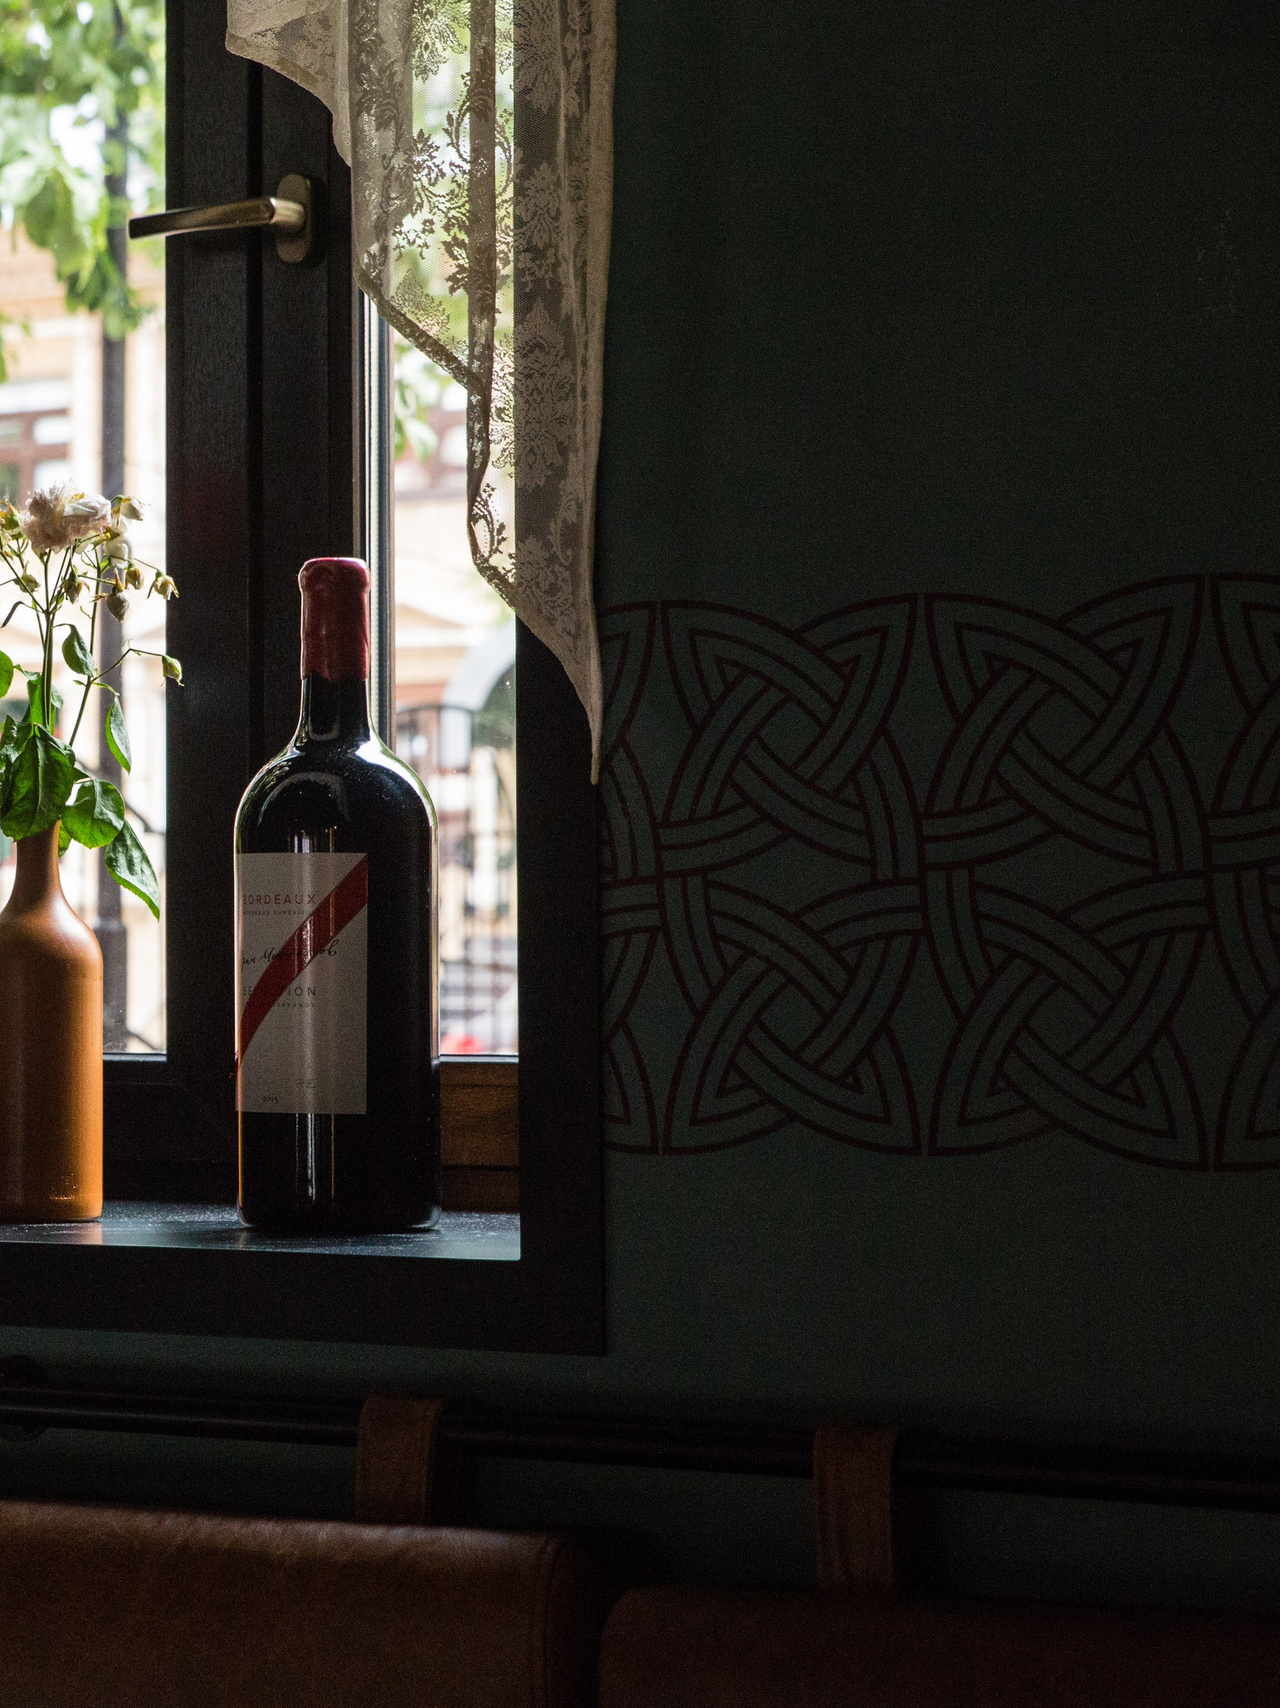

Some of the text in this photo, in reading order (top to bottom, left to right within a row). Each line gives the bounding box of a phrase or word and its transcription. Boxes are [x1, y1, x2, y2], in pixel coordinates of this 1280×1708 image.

[242, 894, 317, 905] BORDEAUX
[242, 986, 317, 997] SEION
[262, 1095, 279, 1104] 2015
